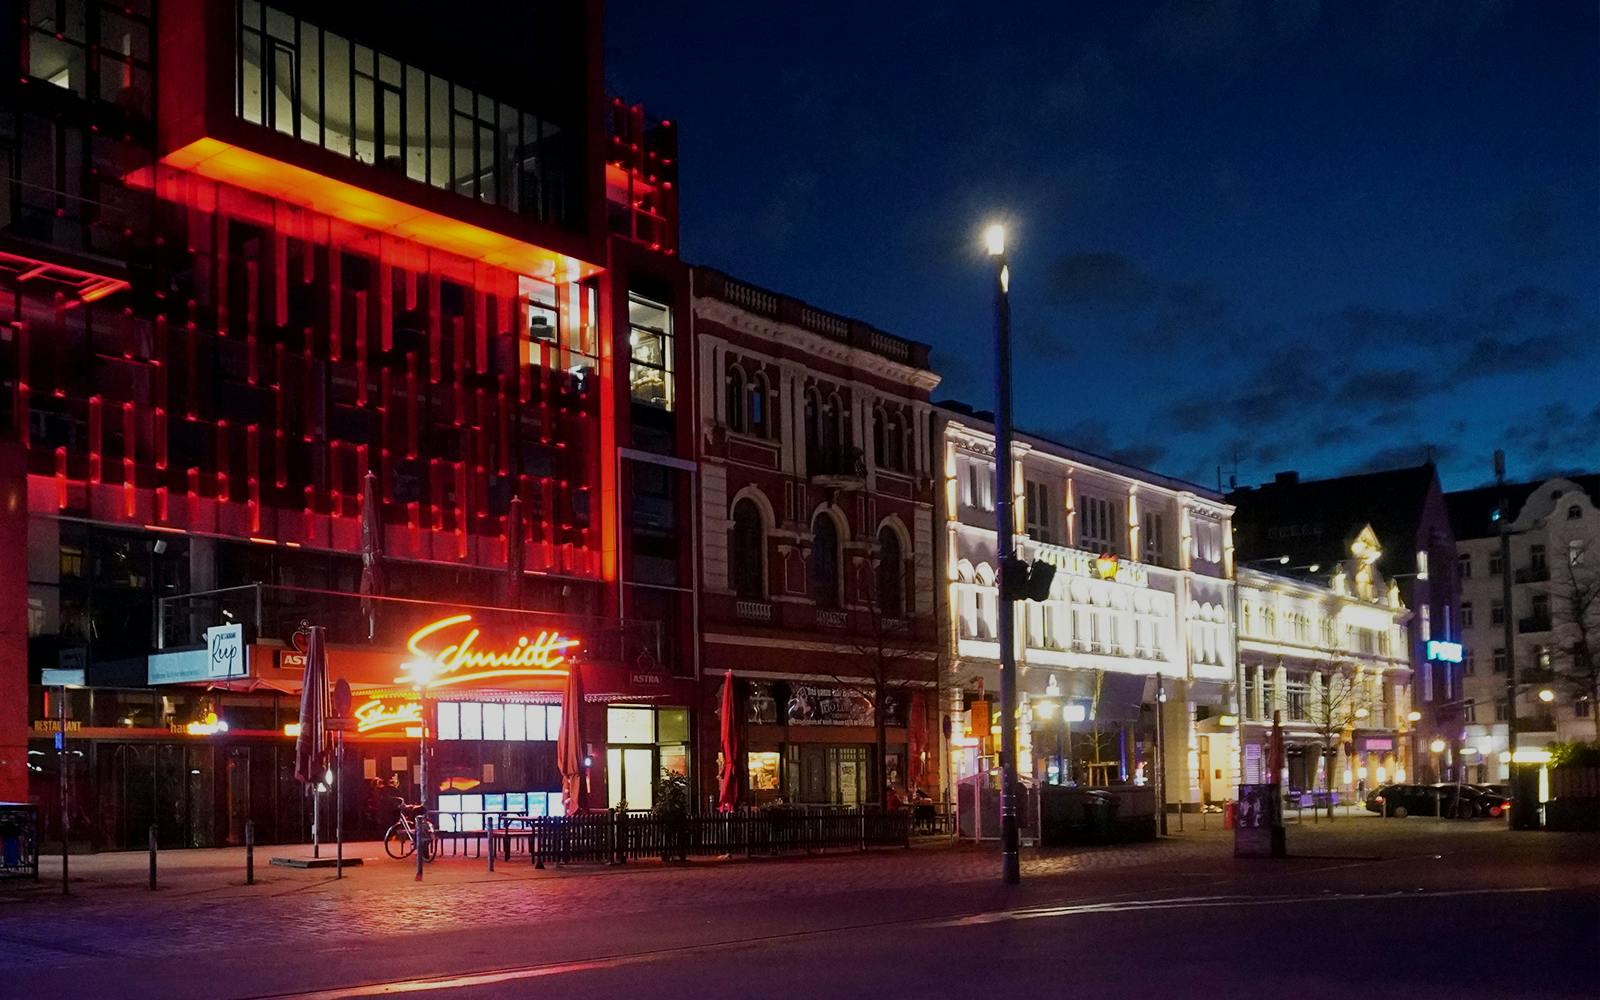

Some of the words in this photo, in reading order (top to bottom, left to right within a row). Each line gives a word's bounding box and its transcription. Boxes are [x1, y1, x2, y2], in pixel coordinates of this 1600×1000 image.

[398, 614, 579, 676] Schmidt
[284, 655, 308, 665] AST
[633, 674, 660, 684] ASTRA
